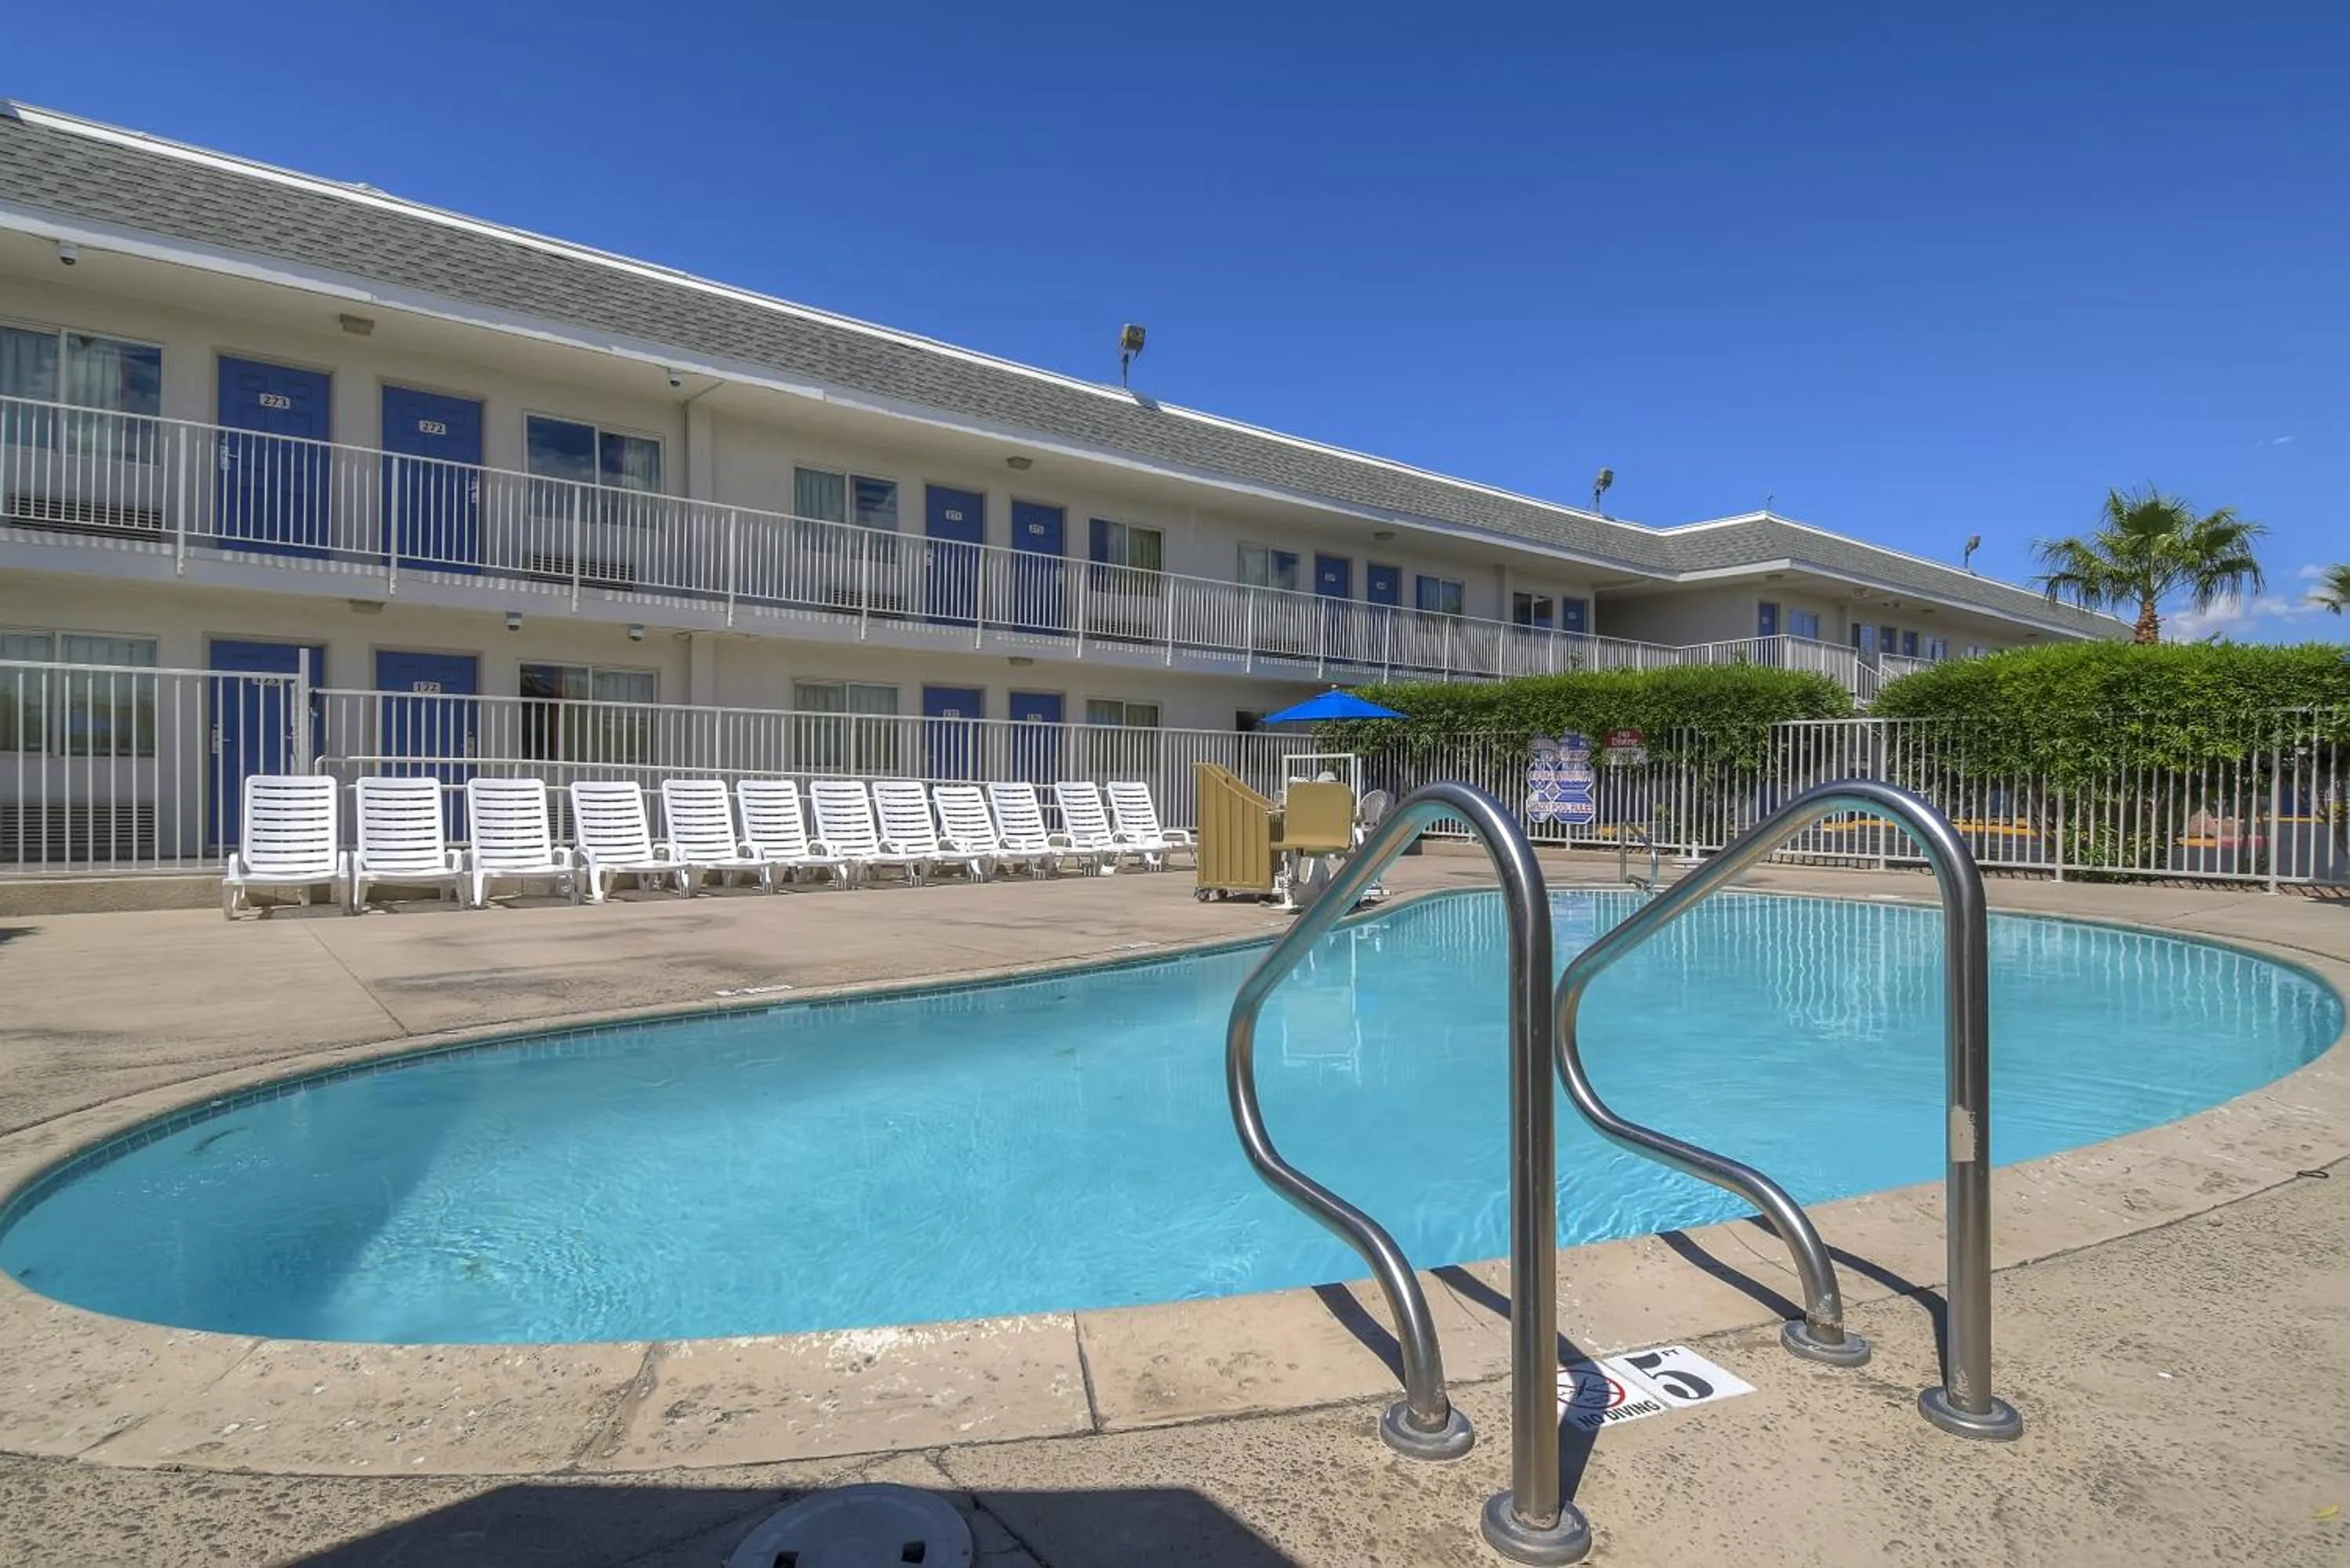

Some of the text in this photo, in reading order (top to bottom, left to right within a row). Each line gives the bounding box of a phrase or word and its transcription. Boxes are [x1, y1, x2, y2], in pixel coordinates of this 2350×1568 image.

[1624, 1349, 1714, 1400] 5 FT
[1577, 1399, 1661, 1428] NO DIVING
